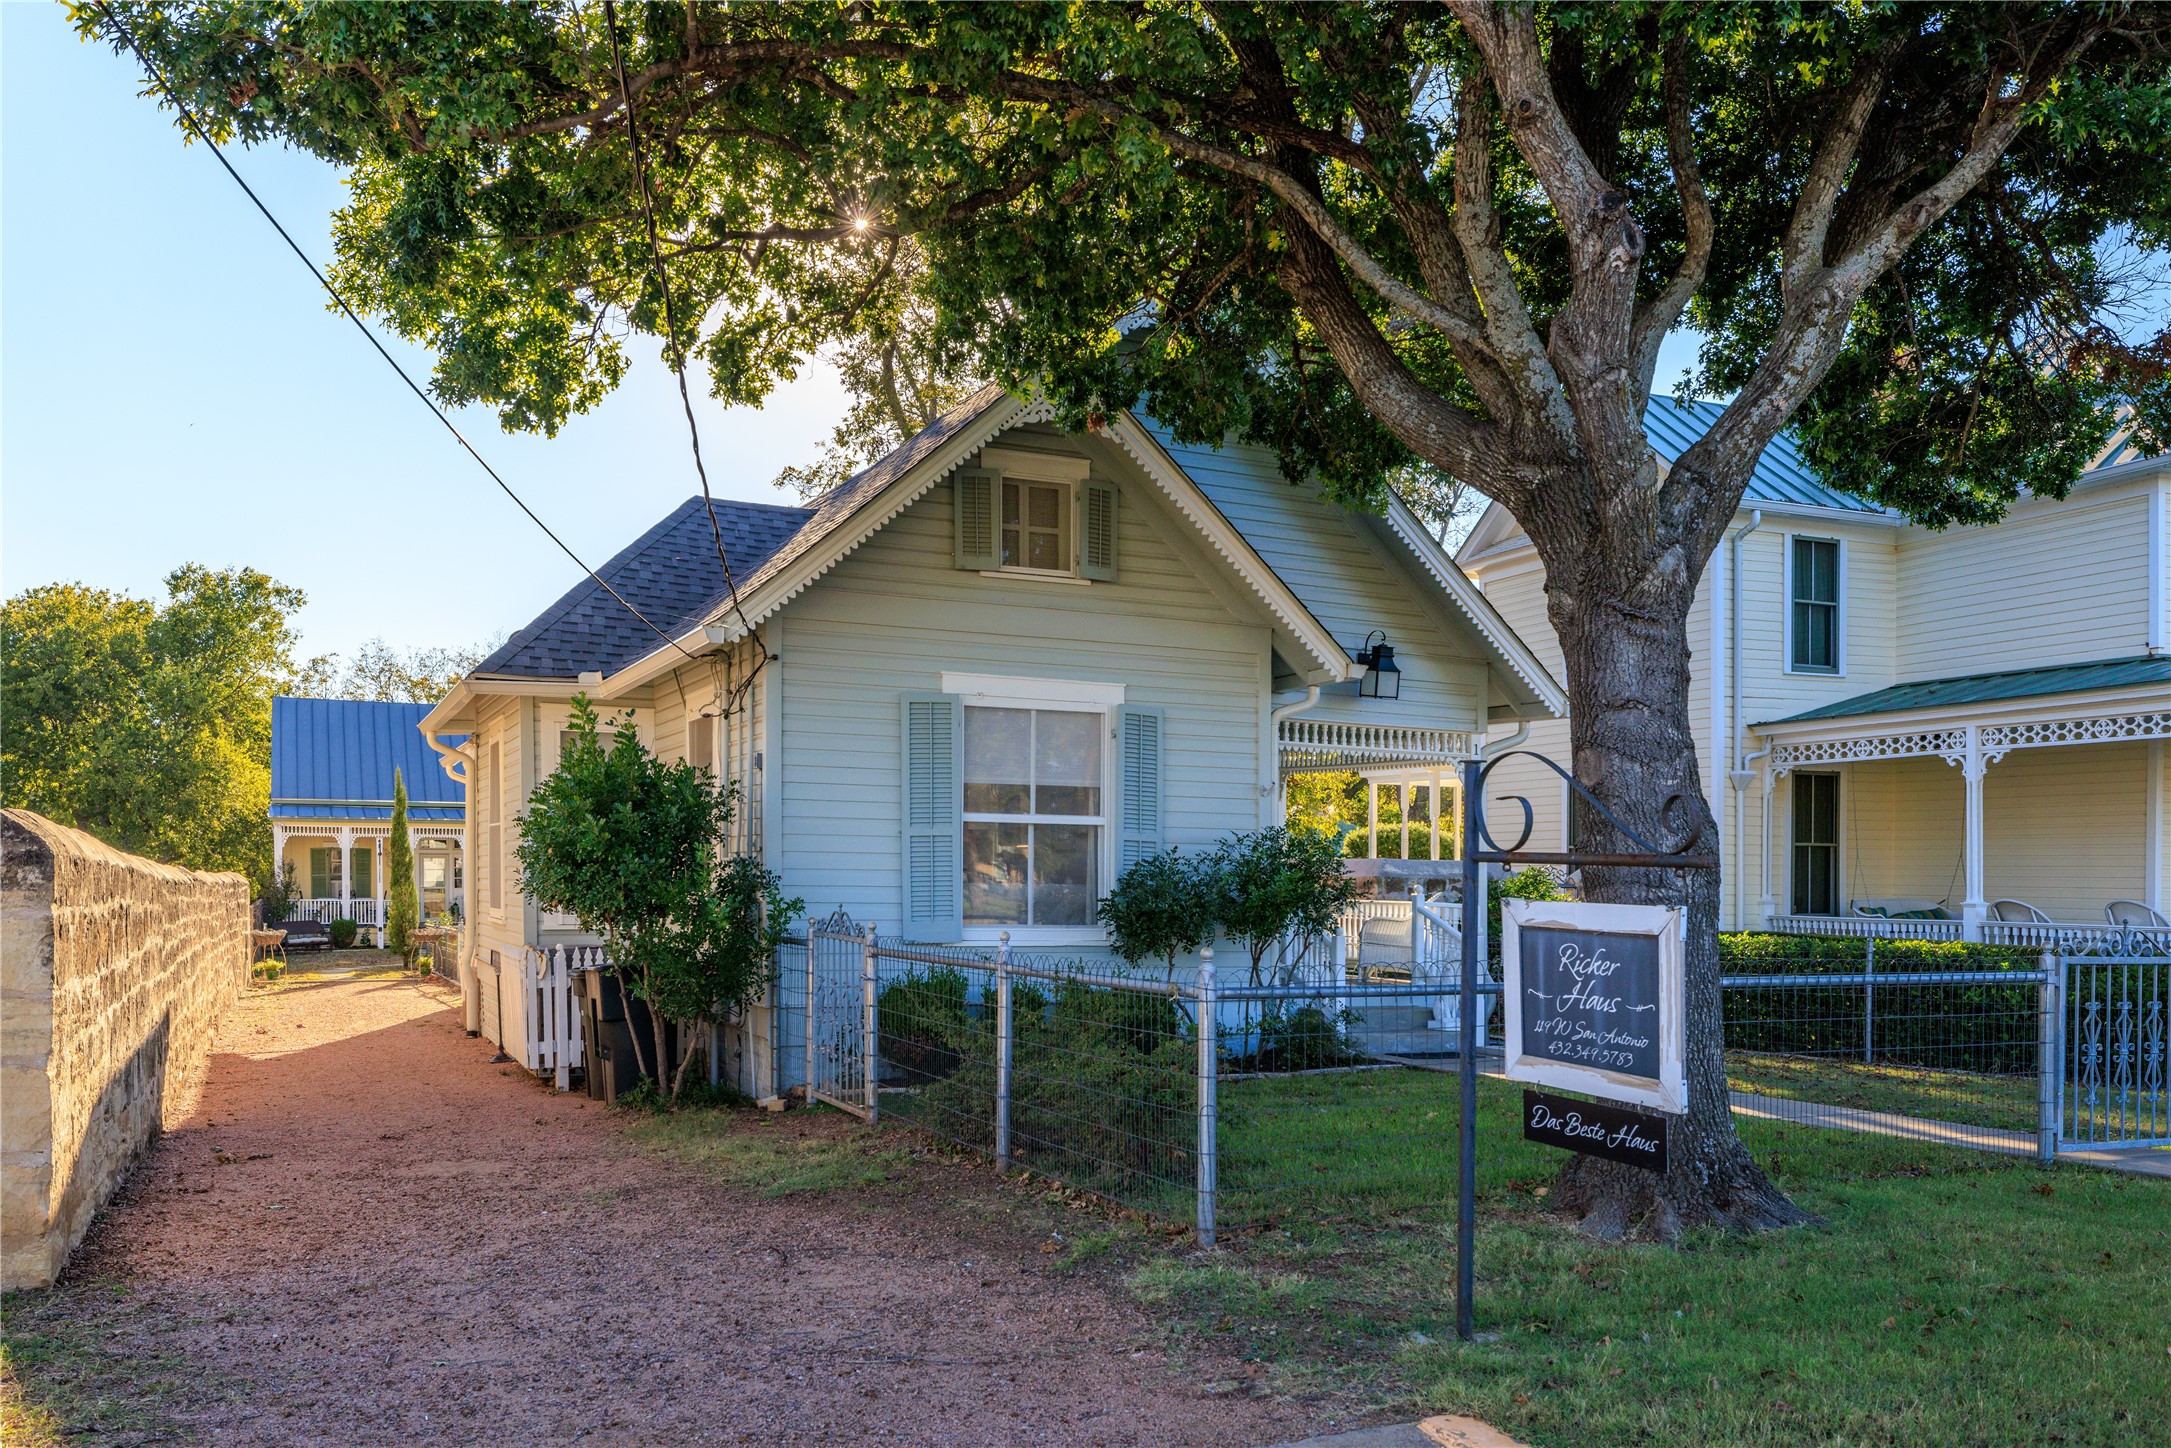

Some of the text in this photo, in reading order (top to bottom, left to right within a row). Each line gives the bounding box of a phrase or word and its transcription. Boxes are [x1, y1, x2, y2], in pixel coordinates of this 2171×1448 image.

[1559, 943, 1620, 980] Ricker
[1556, 980, 1621, 1012] Haus
[1552, 1017, 1572, 1036] W
[1572, 1021, 1597, 1040] San
[1598, 1027, 1649, 1048] Antonio
[1548, 1041, 1634, 1068] 432.349.5783
[1531, 1105, 1659, 1152] Das Beste Haus
